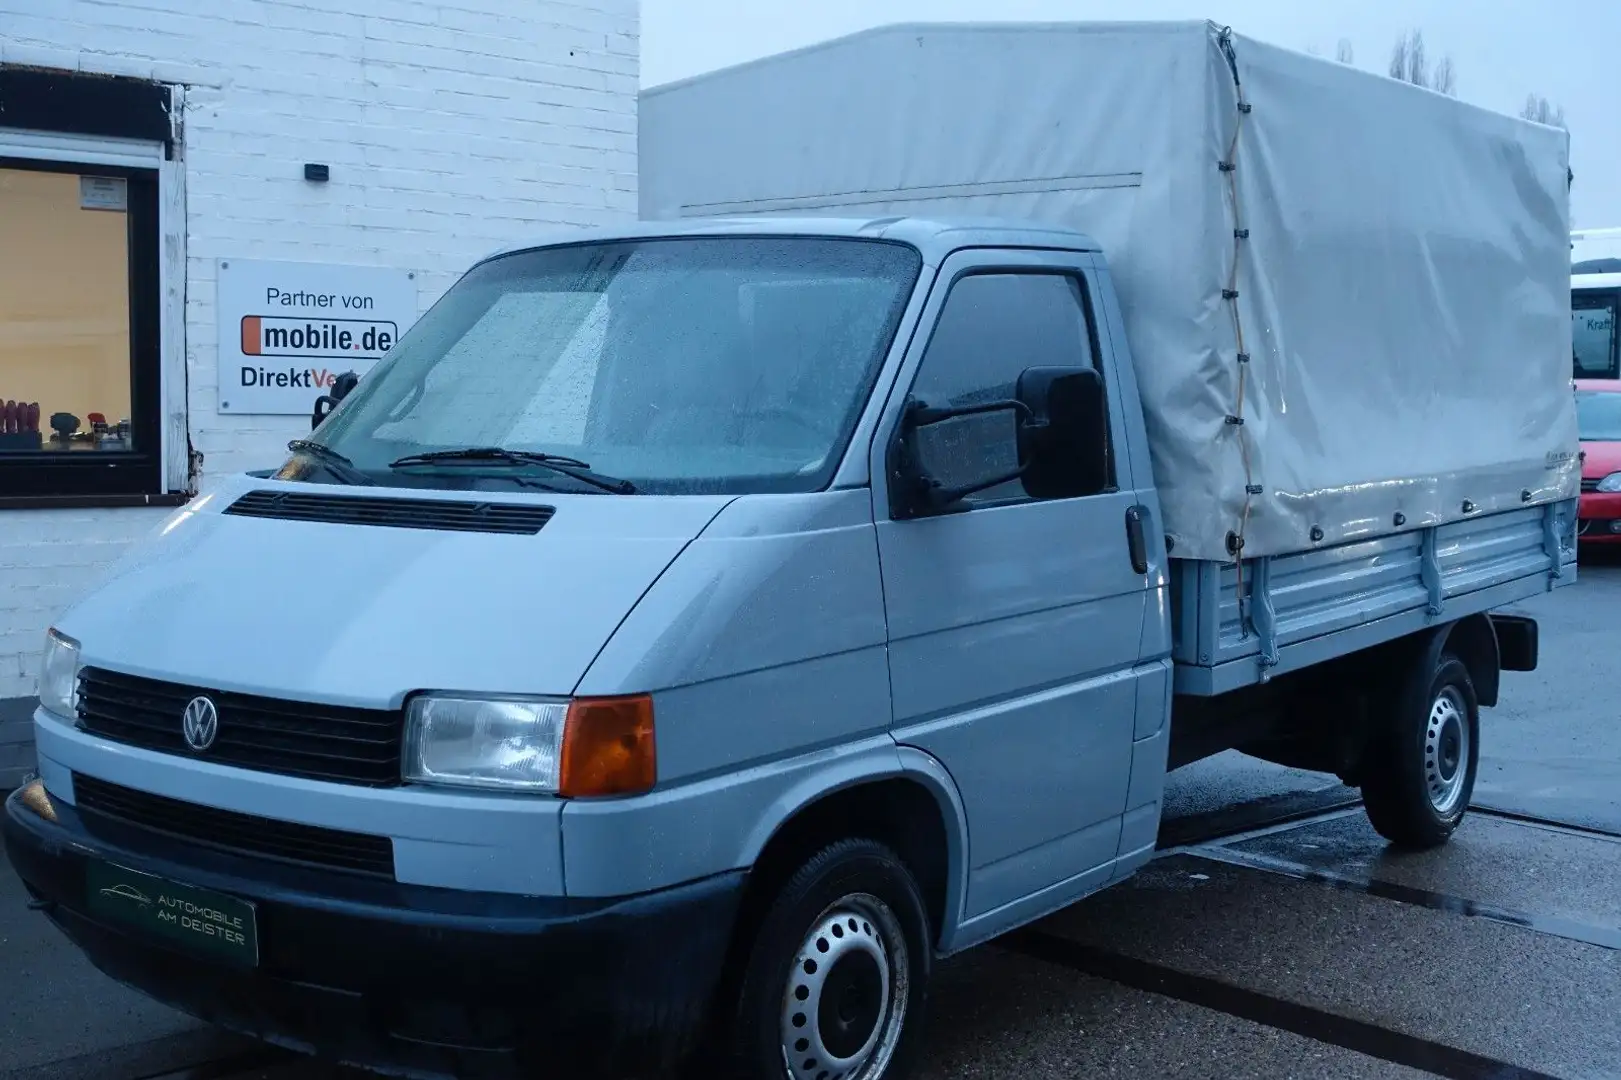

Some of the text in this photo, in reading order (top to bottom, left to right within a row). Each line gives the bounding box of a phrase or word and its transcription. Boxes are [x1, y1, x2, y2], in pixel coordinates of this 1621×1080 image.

[266, 287, 374, 309] Partner von
[264, 323, 392, 351] mobile.de
[241, 366, 337, 388] DirektVe
[158, 894, 243, 930] AUTOMOBILE
[157, 909, 246, 946] AM DEISTER
